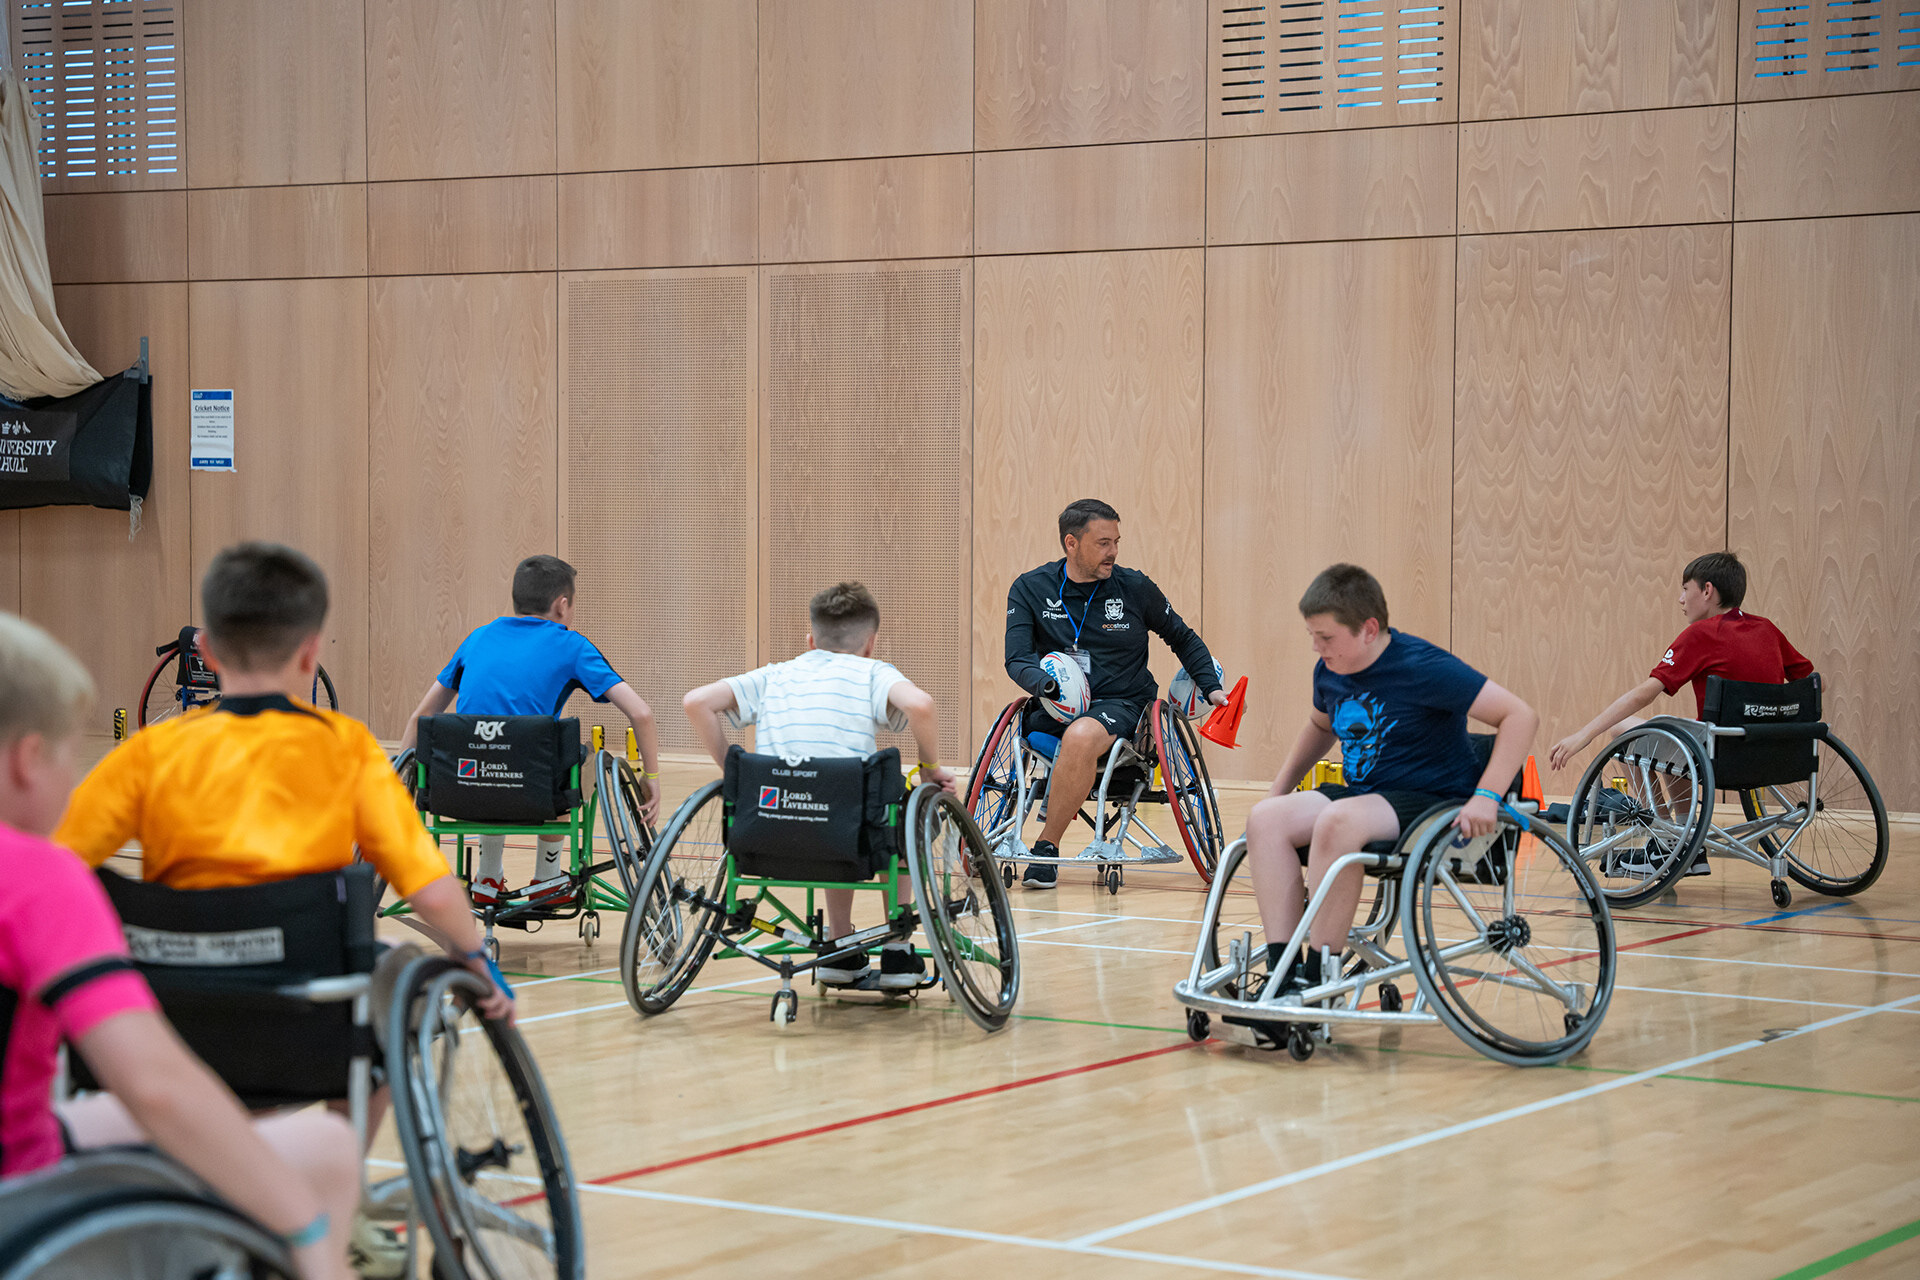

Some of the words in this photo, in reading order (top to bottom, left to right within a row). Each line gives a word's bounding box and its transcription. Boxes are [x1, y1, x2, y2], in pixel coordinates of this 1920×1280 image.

[195, 404, 213, 413] Cricket
[213, 404, 230, 412] Notice
[0, 439, 57, 456] IVERSITY
[0, 456, 28, 473] HULL
[474, 720, 506, 741] RGK
[479, 768, 524, 779] TAVERNERS
[771, 768, 791, 776] CLUB
[792, 770, 818, 778] SPORT
[781, 798, 830, 811] TAVERNERS
